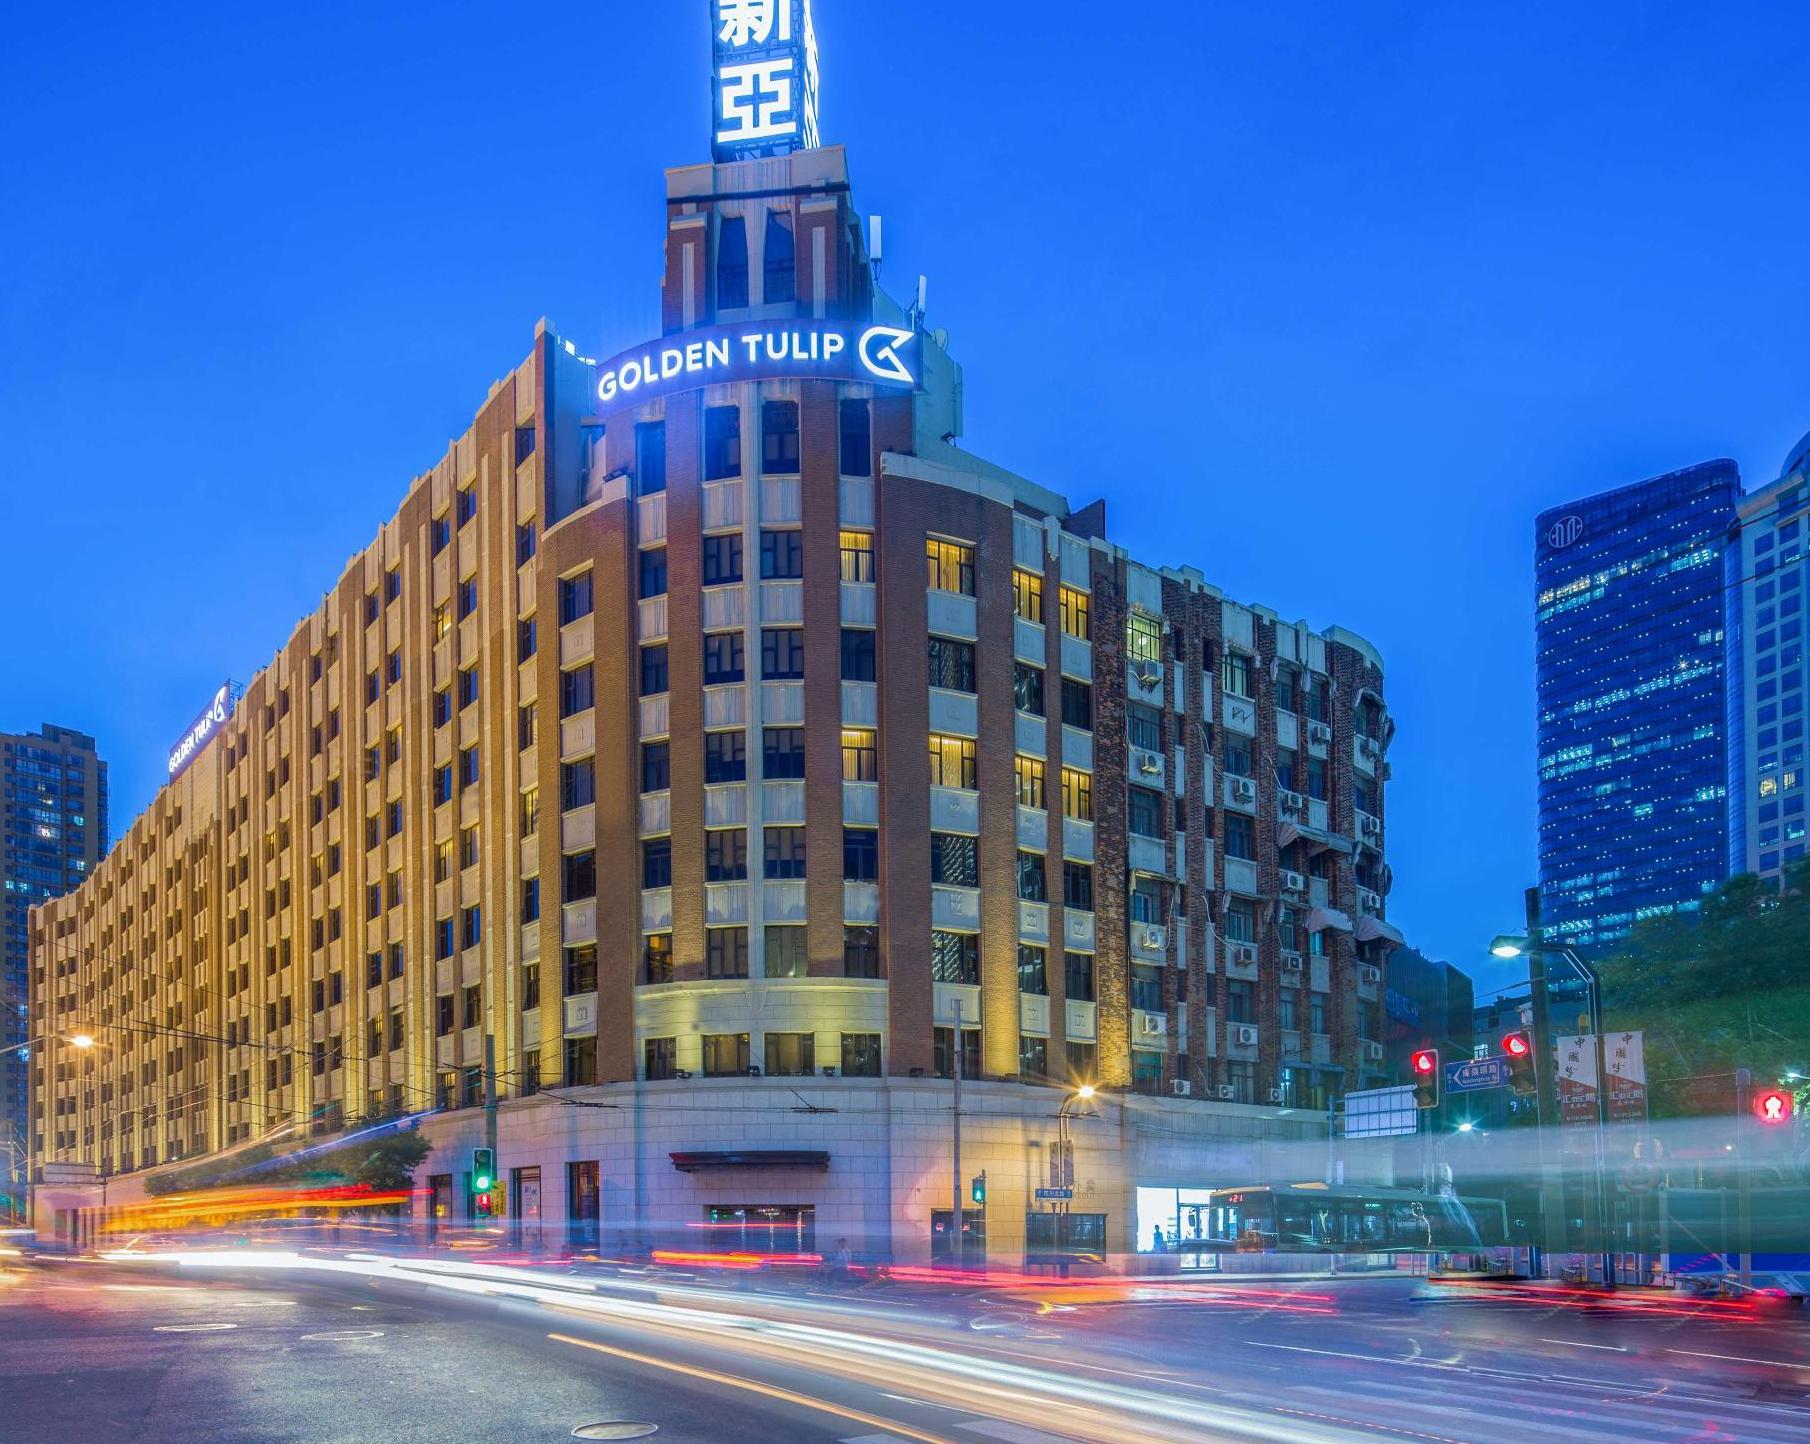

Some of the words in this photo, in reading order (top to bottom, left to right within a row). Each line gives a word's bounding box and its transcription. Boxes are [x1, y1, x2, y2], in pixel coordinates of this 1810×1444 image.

[598, 338, 730, 401] GOLDEN
[742, 332, 844, 368] TULIP
[168, 732, 195, 773] GOLDEN
